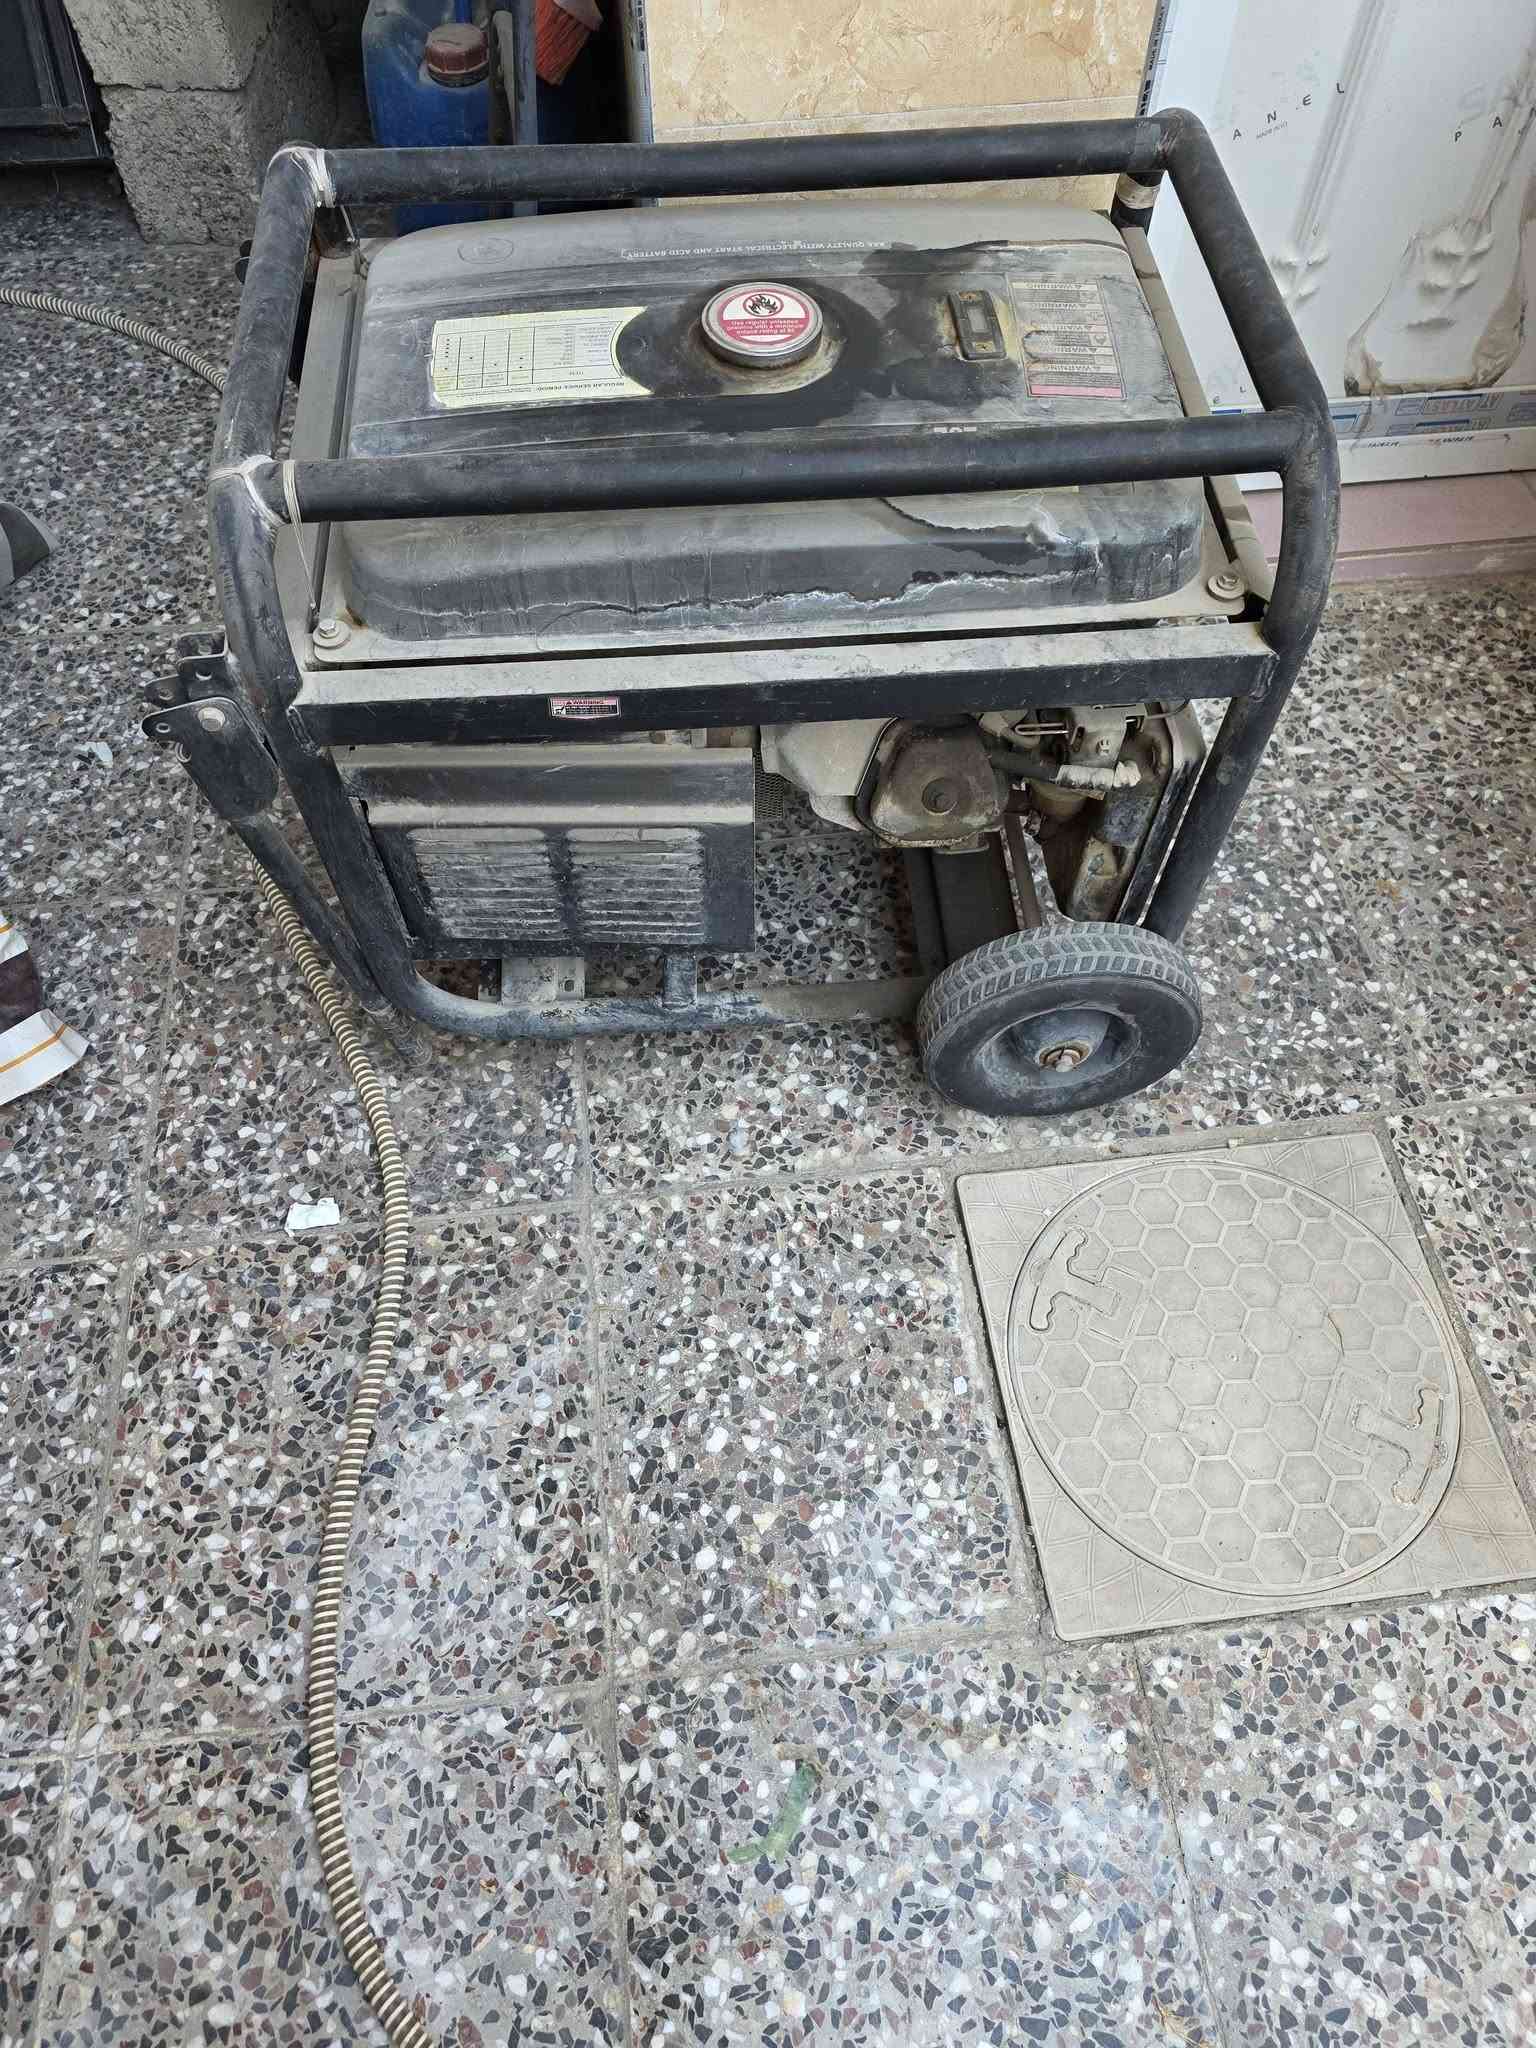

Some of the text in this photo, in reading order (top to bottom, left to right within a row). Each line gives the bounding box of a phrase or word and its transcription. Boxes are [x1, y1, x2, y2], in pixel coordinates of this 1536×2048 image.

[799, 242, 825, 250] WITH
[826, 240, 865, 249] QUALITY
[627, 250, 666, 259] BATTERY
[693, 247, 712, 255] AND
